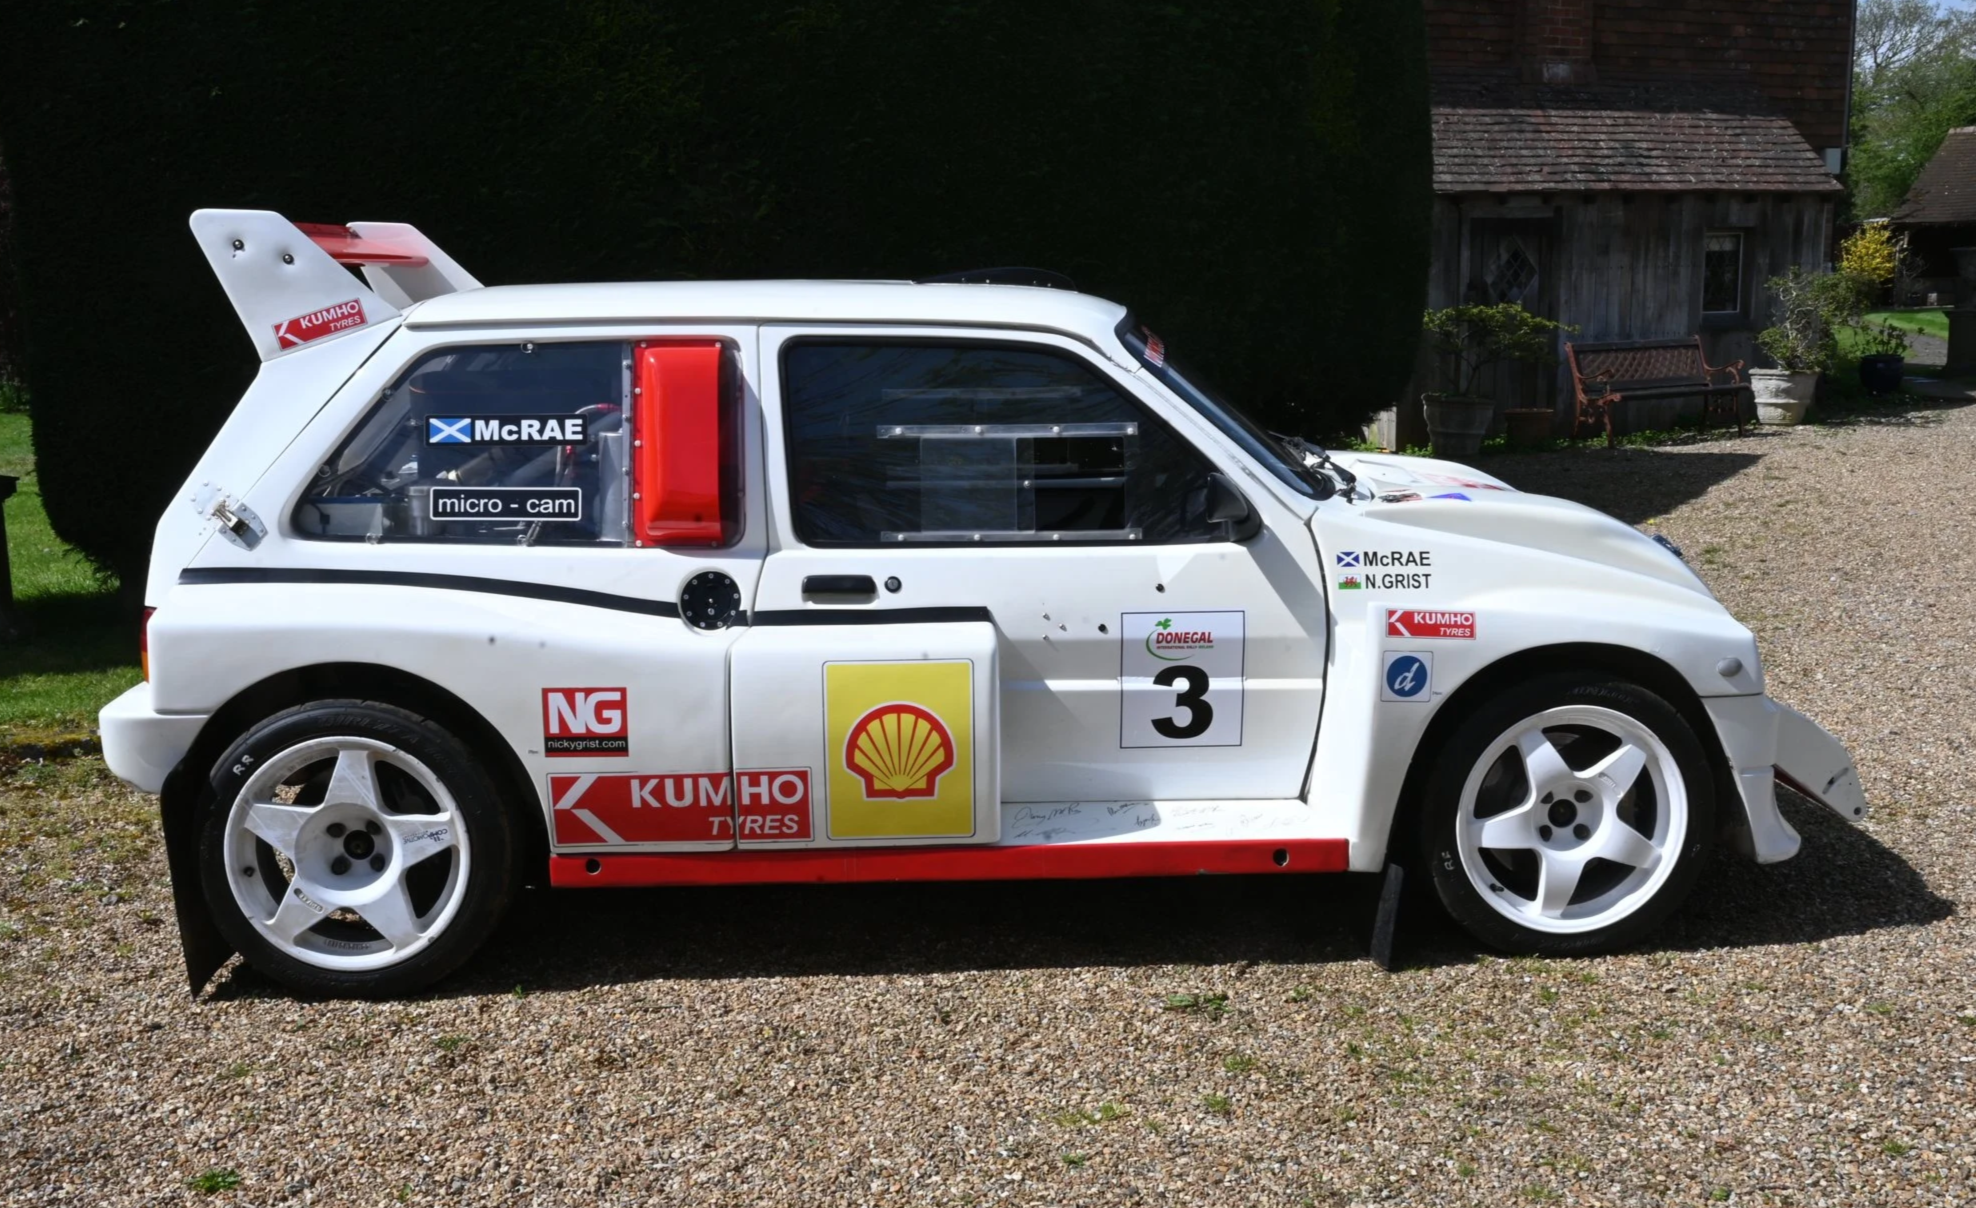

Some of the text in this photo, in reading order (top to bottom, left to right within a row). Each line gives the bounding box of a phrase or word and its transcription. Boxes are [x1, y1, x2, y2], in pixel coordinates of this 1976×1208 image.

[300, 302, 359, 329] KUMHO
[329, 315, 361, 331] TYRES
[475, 419, 583, 441] McRAE
[438, 494, 502, 513] micro
[526, 499, 575, 513] cam
[1363, 551, 1431, 567] McRAE
[1365, 573, 1432, 589] N.GRIST
[1414, 612, 1473, 625] KUMHO
[1156, 631, 1213, 644] DONEGAL
[1439, 627, 1471, 637] TYRES
[1151, 665, 1214, 739] 3
[548, 691, 622, 733] NG
[547, 739, 626, 750] nickygrist.com
[630, 774, 805, 808] KUMHO
[708, 814, 799, 836] TYRES
